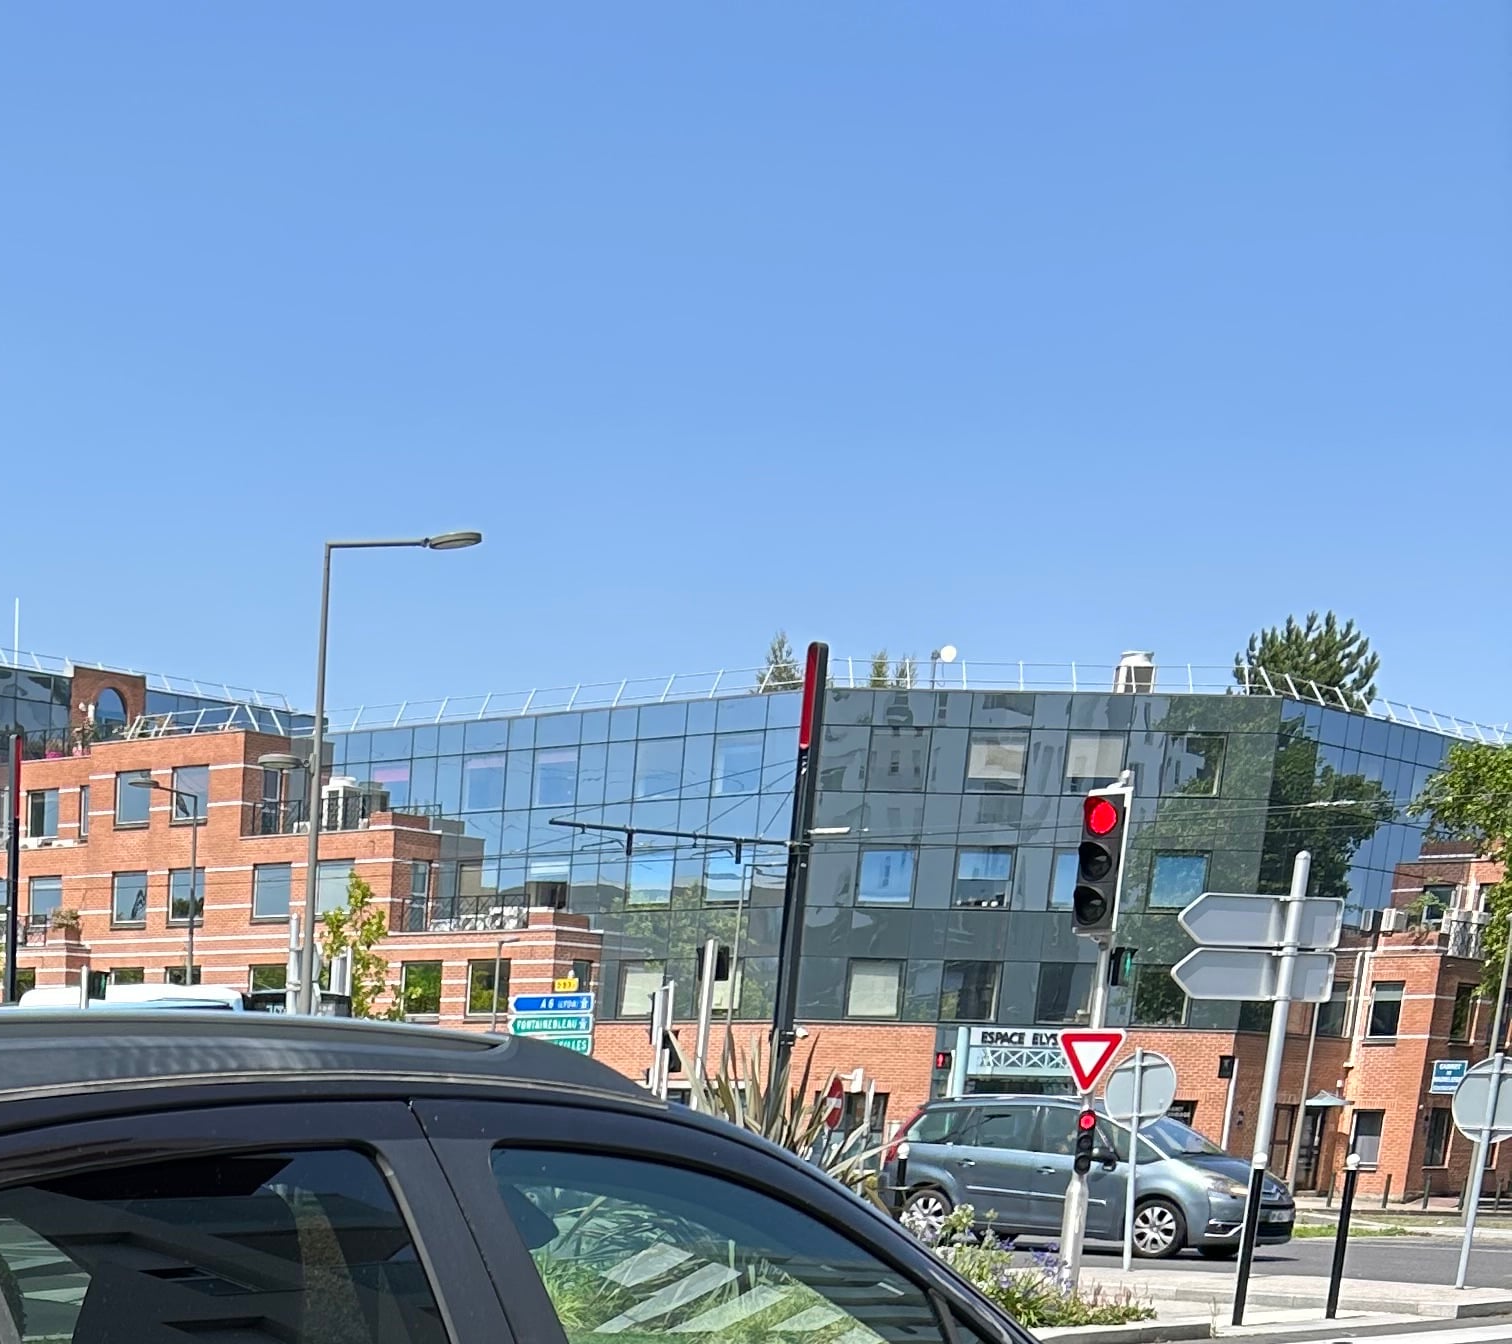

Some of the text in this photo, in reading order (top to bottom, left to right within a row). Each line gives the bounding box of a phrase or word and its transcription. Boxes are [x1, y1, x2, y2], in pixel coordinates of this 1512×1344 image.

[540, 998, 546, 1009] A
[548, 998, 555, 1009] 6
[516, 1018, 578, 1030] FONTAINEBLEAU
[981, 1031, 1058, 1046] ESPACE ELYS
